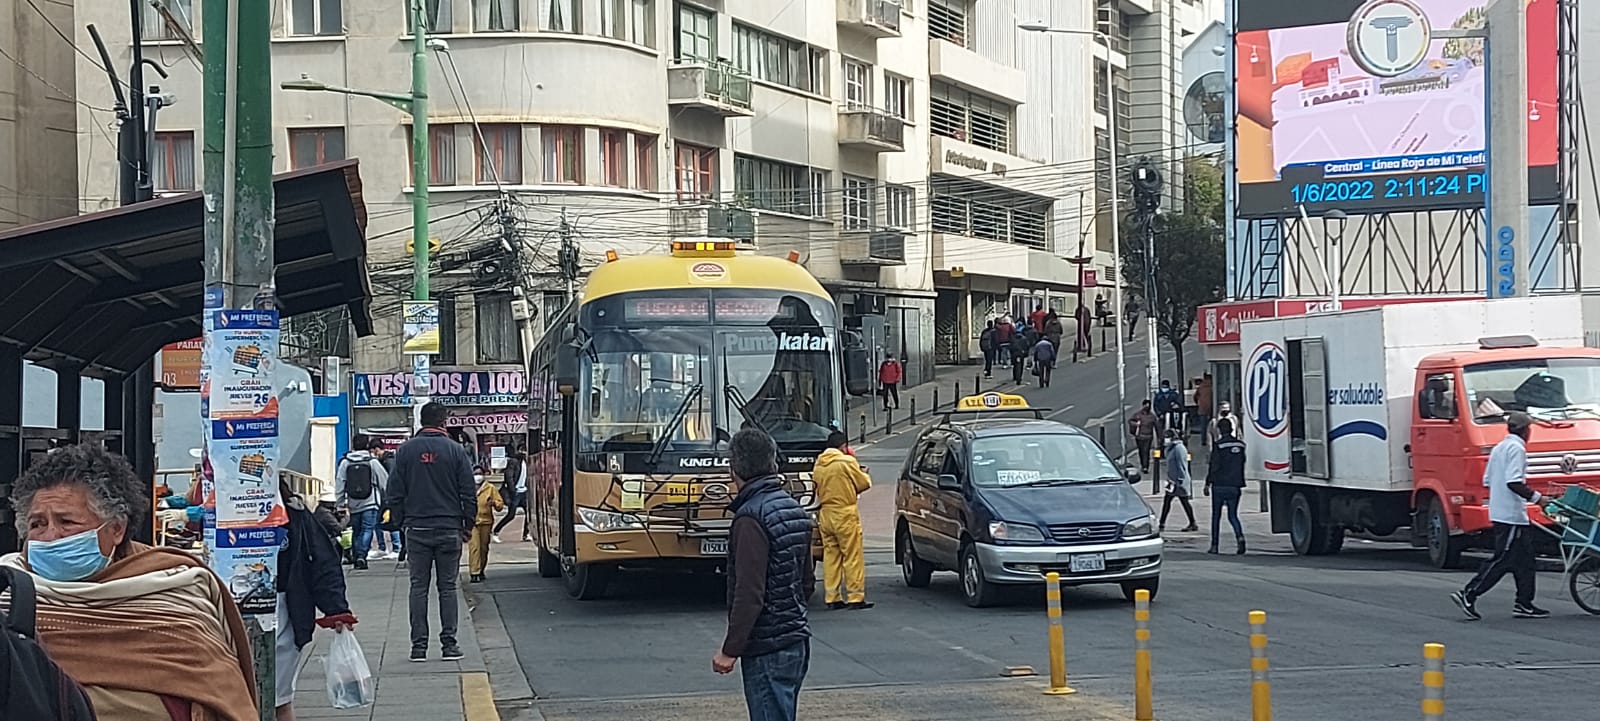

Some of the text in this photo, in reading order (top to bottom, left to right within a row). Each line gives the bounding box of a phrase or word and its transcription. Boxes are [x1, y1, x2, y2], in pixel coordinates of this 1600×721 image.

[1324, 160, 1363, 173] Central
[1401, 158, 1425, 170] Roja
[1426, 156, 1441, 167] de
[1441, 154, 1455, 165] Mi
[1291, 180, 1374, 203] 1/6/2022
[1385, 175, 1460, 199] 2:11:24
[1498, 226, 1515, 296] RADO
[164, 373, 177, 387] 03
[368, 373, 463, 396] VESTDOS
[468, 373, 481, 394] A
[1253, 347, 1285, 421] Pil
[254, 393, 269, 404] 26
[1339, 382, 1384, 405] saludable
[449, 412, 528, 427] OTOCOPIAS
[679, 457, 712, 468] KING
[258, 501, 272, 513] 26
